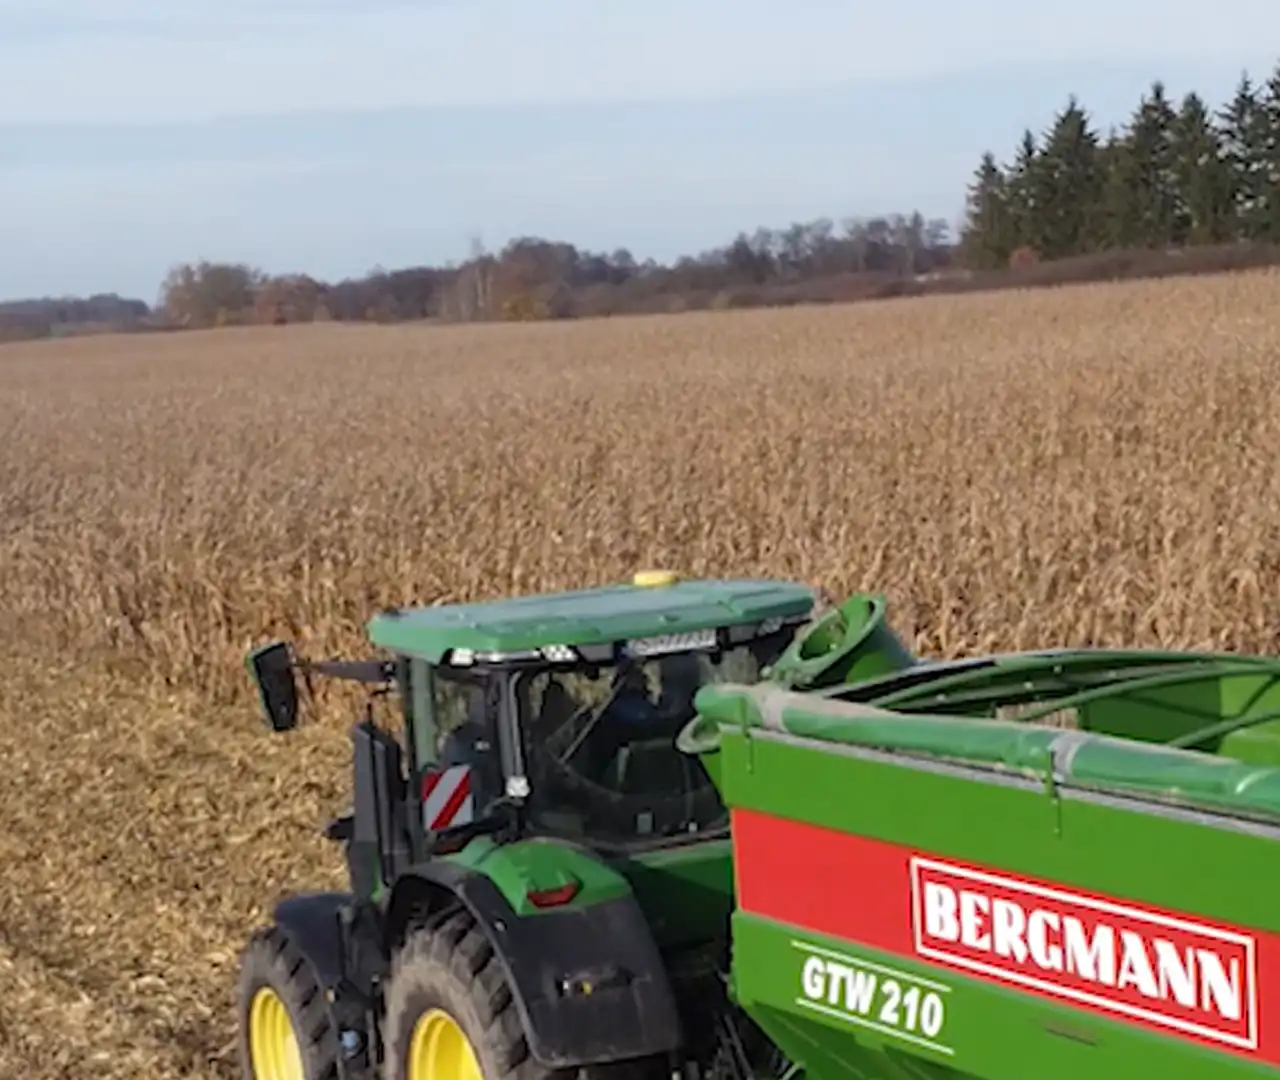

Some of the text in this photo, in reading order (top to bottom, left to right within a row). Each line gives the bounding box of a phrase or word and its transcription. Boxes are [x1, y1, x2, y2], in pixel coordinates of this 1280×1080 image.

[802, 955, 945, 1038] GTW 210
[924, 881, 1241, 1021] BERGMANN
